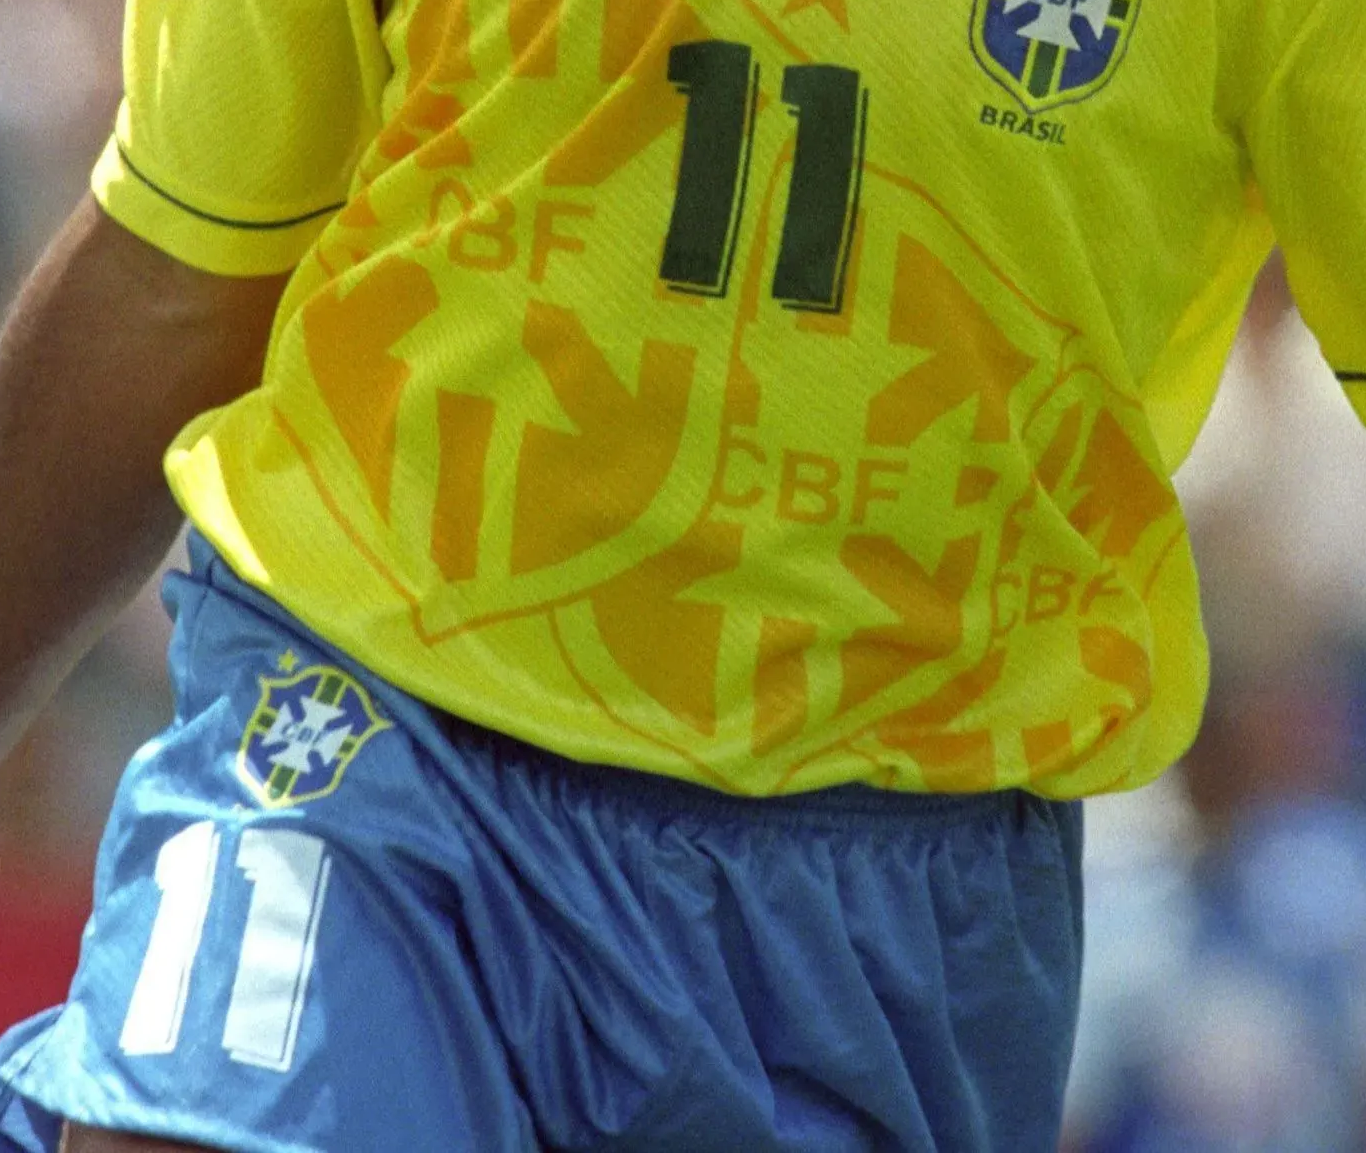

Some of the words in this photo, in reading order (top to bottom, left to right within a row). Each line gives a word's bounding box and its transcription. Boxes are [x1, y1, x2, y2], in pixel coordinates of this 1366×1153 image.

[979, 104, 1067, 145] BRASIL
[659, 39, 869, 316] 11
[716, 439, 909, 526] CBF
[990, 564, 1125, 638] CBF
[118, 819, 333, 1073] 11
